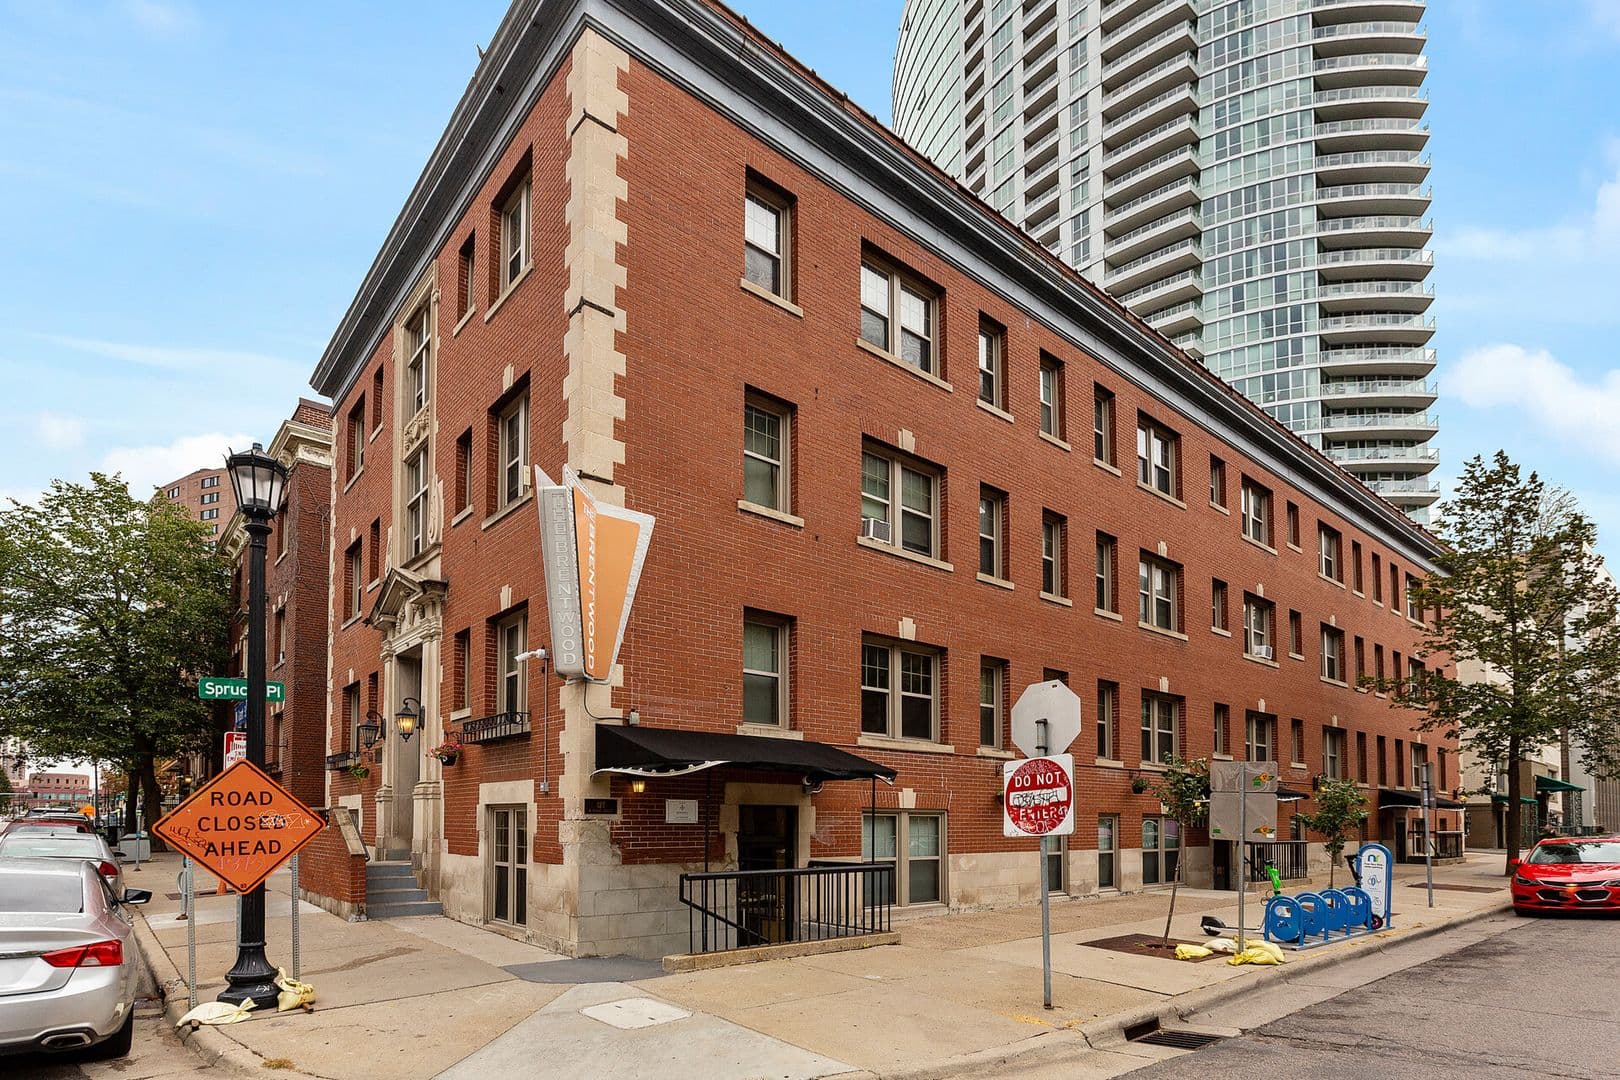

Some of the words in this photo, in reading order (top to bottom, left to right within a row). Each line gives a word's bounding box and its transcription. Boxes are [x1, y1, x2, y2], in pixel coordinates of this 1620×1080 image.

[551, 492, 567, 536] THE
[554, 541, 576, 665] BRENTWOOD
[587, 523, 597, 669] BRENTWOOD
[205, 682, 248, 697] Spruc
[266, 685, 281, 697] Pl
[1015, 775, 1031, 788] DO
[1036, 771, 1061, 786] NOT
[211, 791, 273, 806] ROAD
[1020, 807, 1057, 821] ENTER
[197, 815, 286, 832] CLOSED
[204, 840, 281, 857] AHEAD
